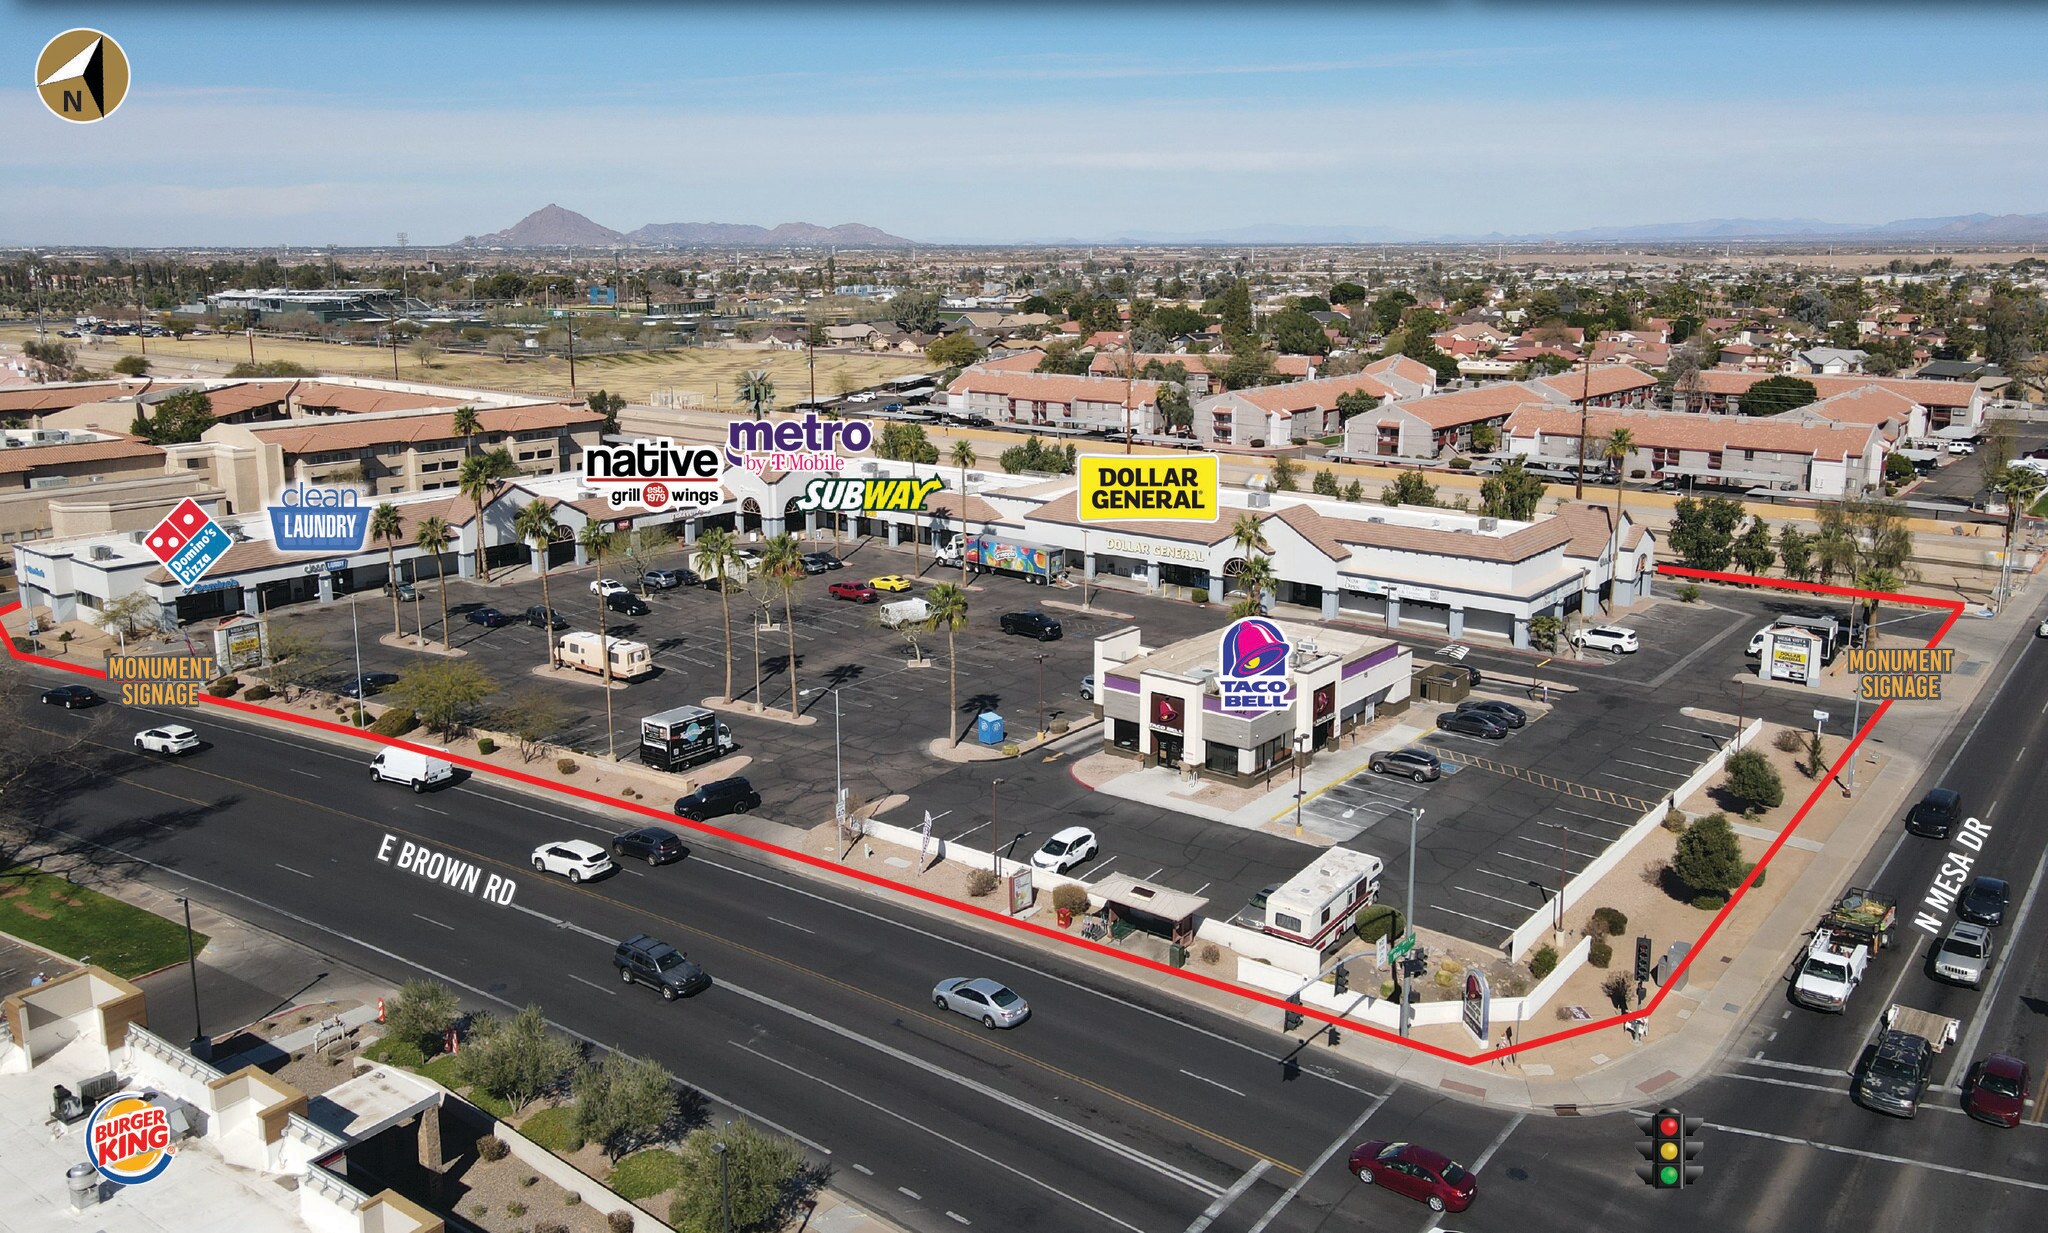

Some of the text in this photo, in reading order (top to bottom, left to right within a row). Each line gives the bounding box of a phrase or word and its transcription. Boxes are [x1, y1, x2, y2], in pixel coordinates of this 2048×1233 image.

[1106, 538, 1206, 562] DOLLAR GENERAL
[304, 562, 327, 574] clean
[1149, 722, 1184, 735] TACO BELL
